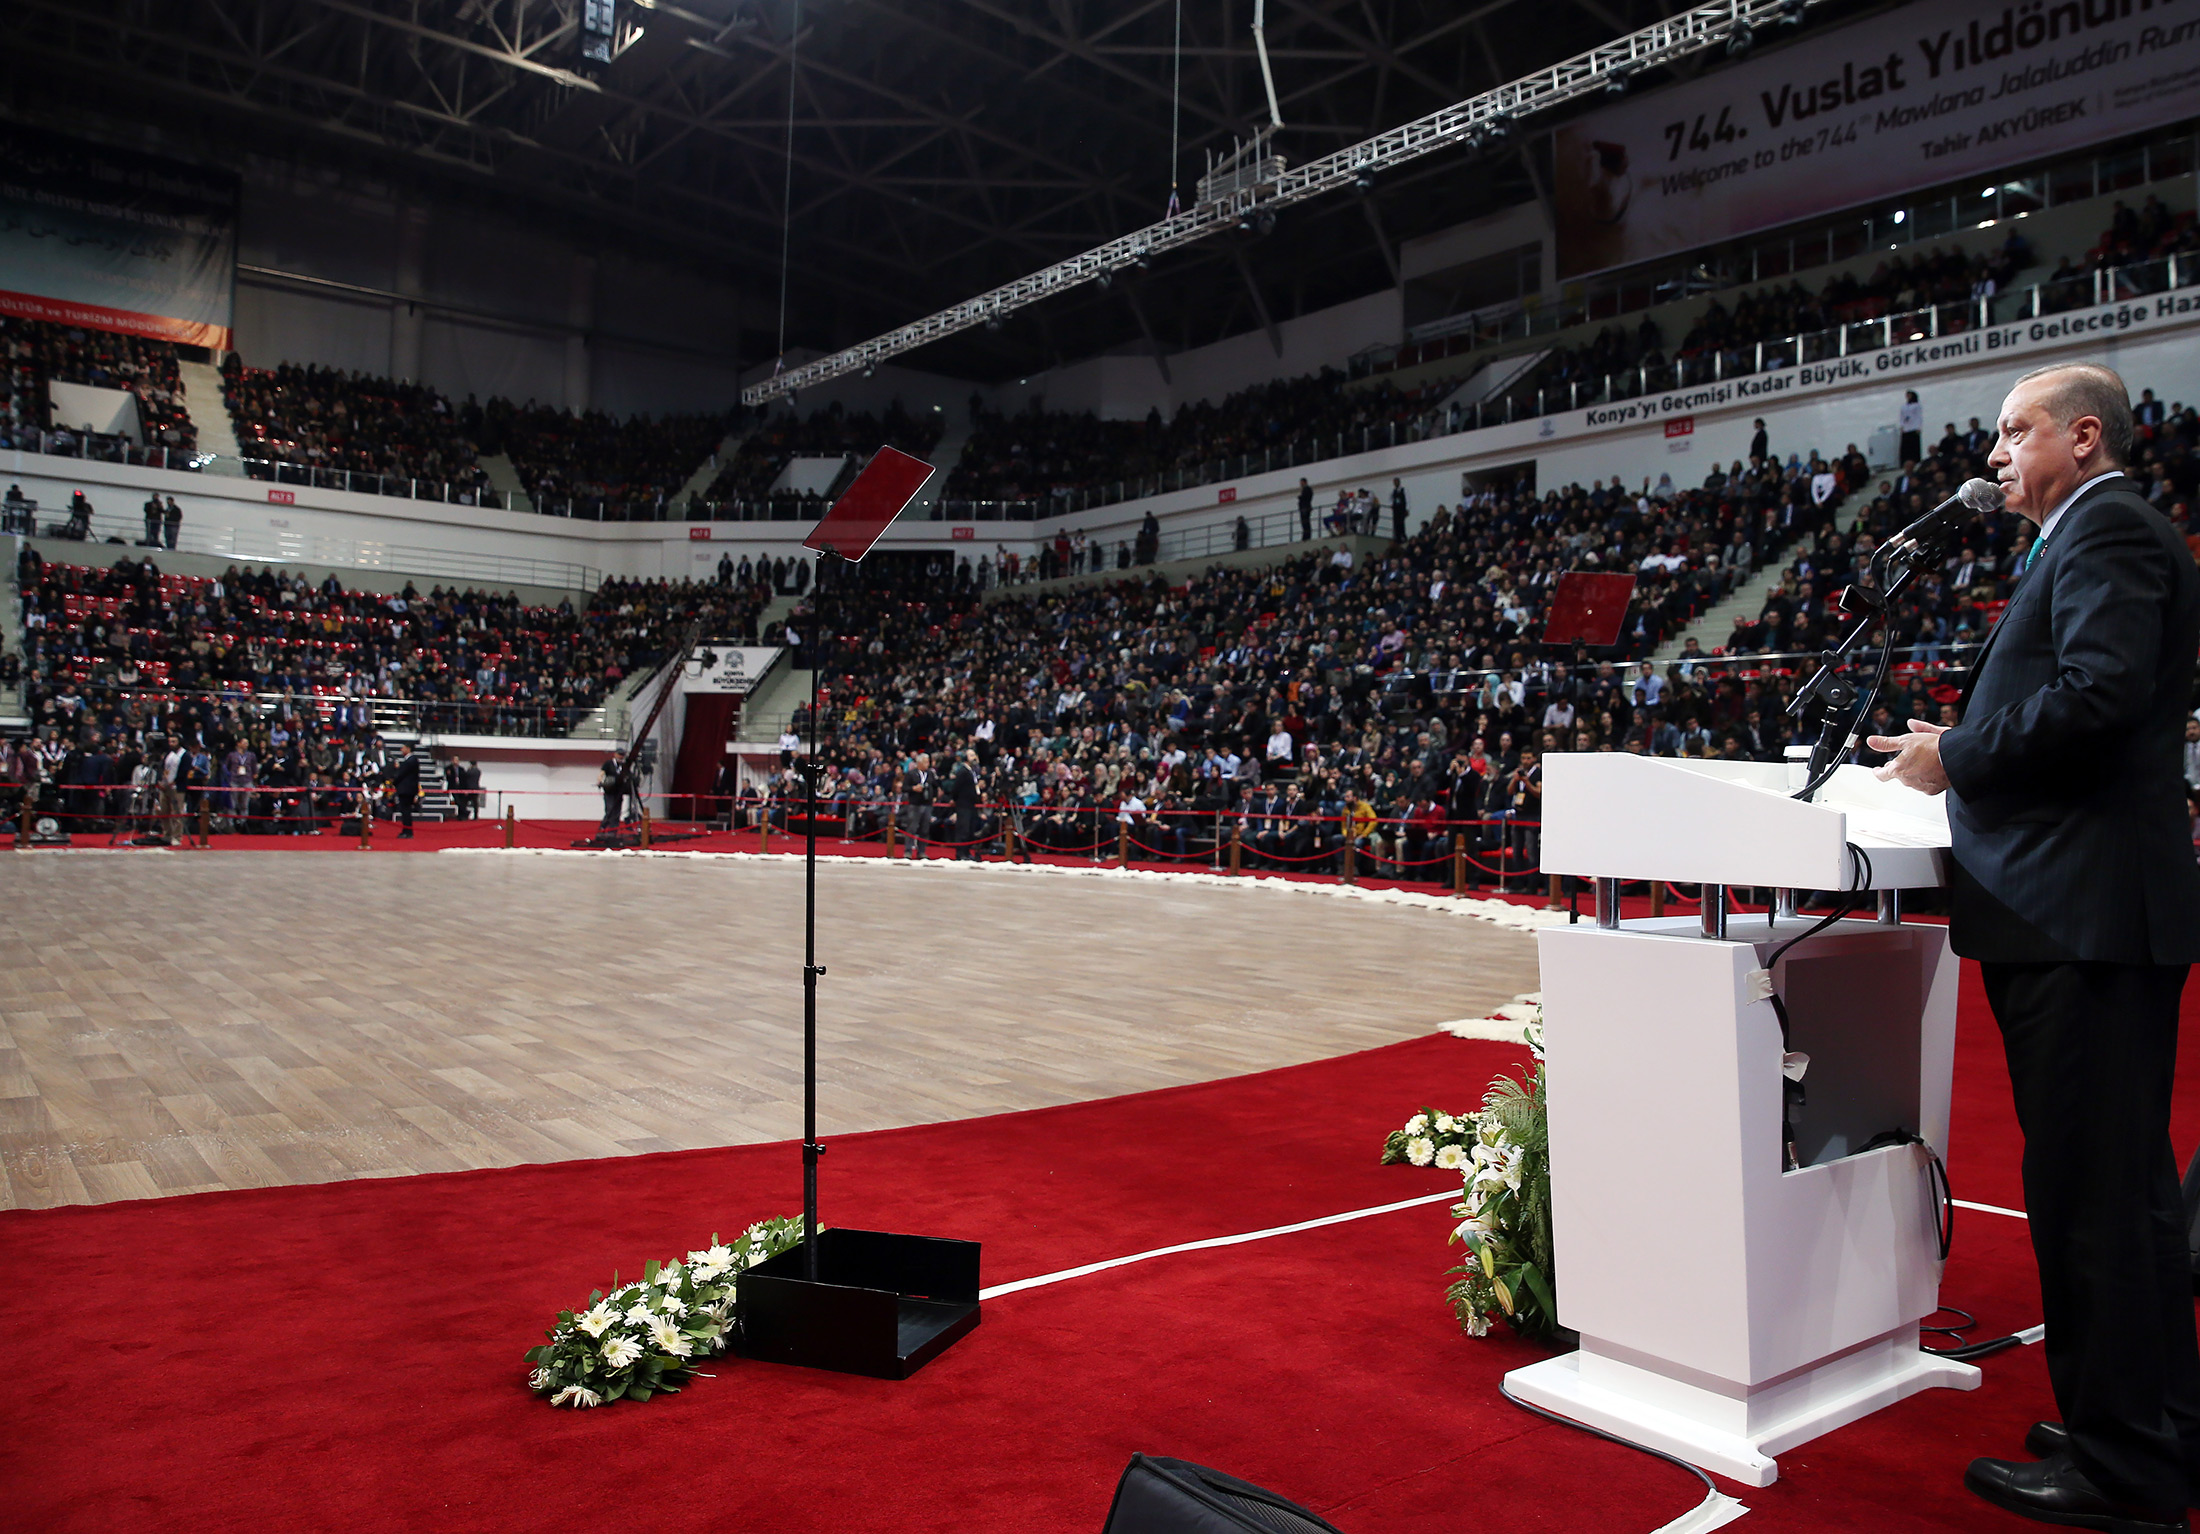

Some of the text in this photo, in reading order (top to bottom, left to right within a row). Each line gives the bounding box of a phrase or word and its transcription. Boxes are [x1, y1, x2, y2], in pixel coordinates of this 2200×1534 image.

[1661, 156, 1749, 196] Welcome
[1754, 149, 1775, 170] to
[1780, 138, 1814, 162] the
[1875, 86, 1985, 134] Mawlana
[1990, 39, 2131, 100] Jalaluddin
[1665, 105, 1747, 162] 744.
[1761, 53, 1906, 129] Vuslat
[1921, 97, 2086, 160] Tahir AKYÜREK
[1586, 401, 1657, 426] Konya'yı
[1662, 383, 1732, 412] Geçmişi
[1737, 374, 1795, 398] Kadar
[1801, 360, 1870, 386] Büyük,
[1876, 334, 1979, 371] Görkemli
[1987, 327, 2022, 350] Bir
[2029, 303, 2148, 341] Geleceğe
